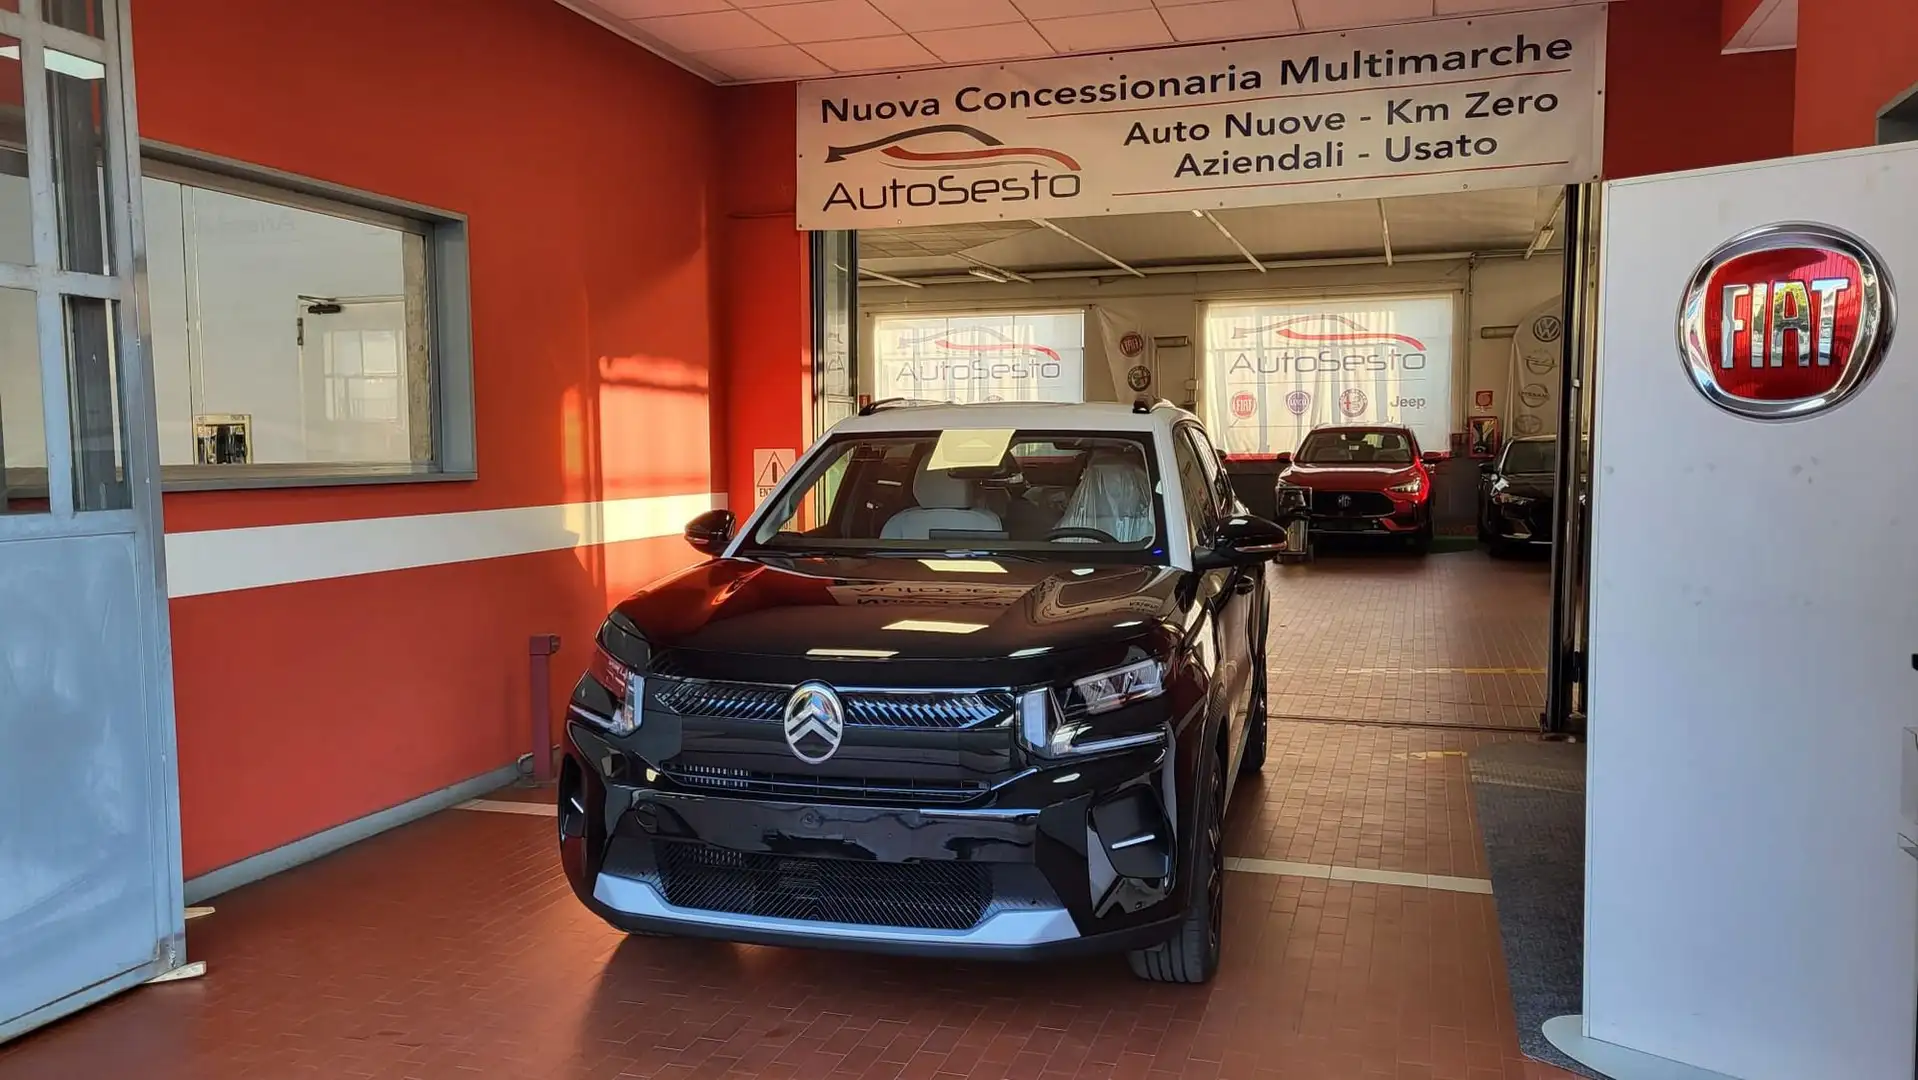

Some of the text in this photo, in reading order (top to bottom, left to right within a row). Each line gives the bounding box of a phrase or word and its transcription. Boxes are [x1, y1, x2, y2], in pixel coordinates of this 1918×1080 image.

[821, 34, 1573, 124] Nuova Concessionaria Multimarche
[1123, 121, 1210, 147] Auto
[1225, 111, 1346, 139] Nuove
[1387, 98, 1449, 125] Km
[1465, 91, 1559, 119] Zero
[1174, 141, 1343, 178] Aziendali
[1385, 134, 1498, 163] Usato
[822, 169, 1081, 212] AutoSesto
[1721, 277, 1849, 369] FIAT
[896, 359, 1061, 382] AutoSesto
[1229, 349, 1427, 374] AutoSesto
[1389, 395, 1427, 409] Jeep
